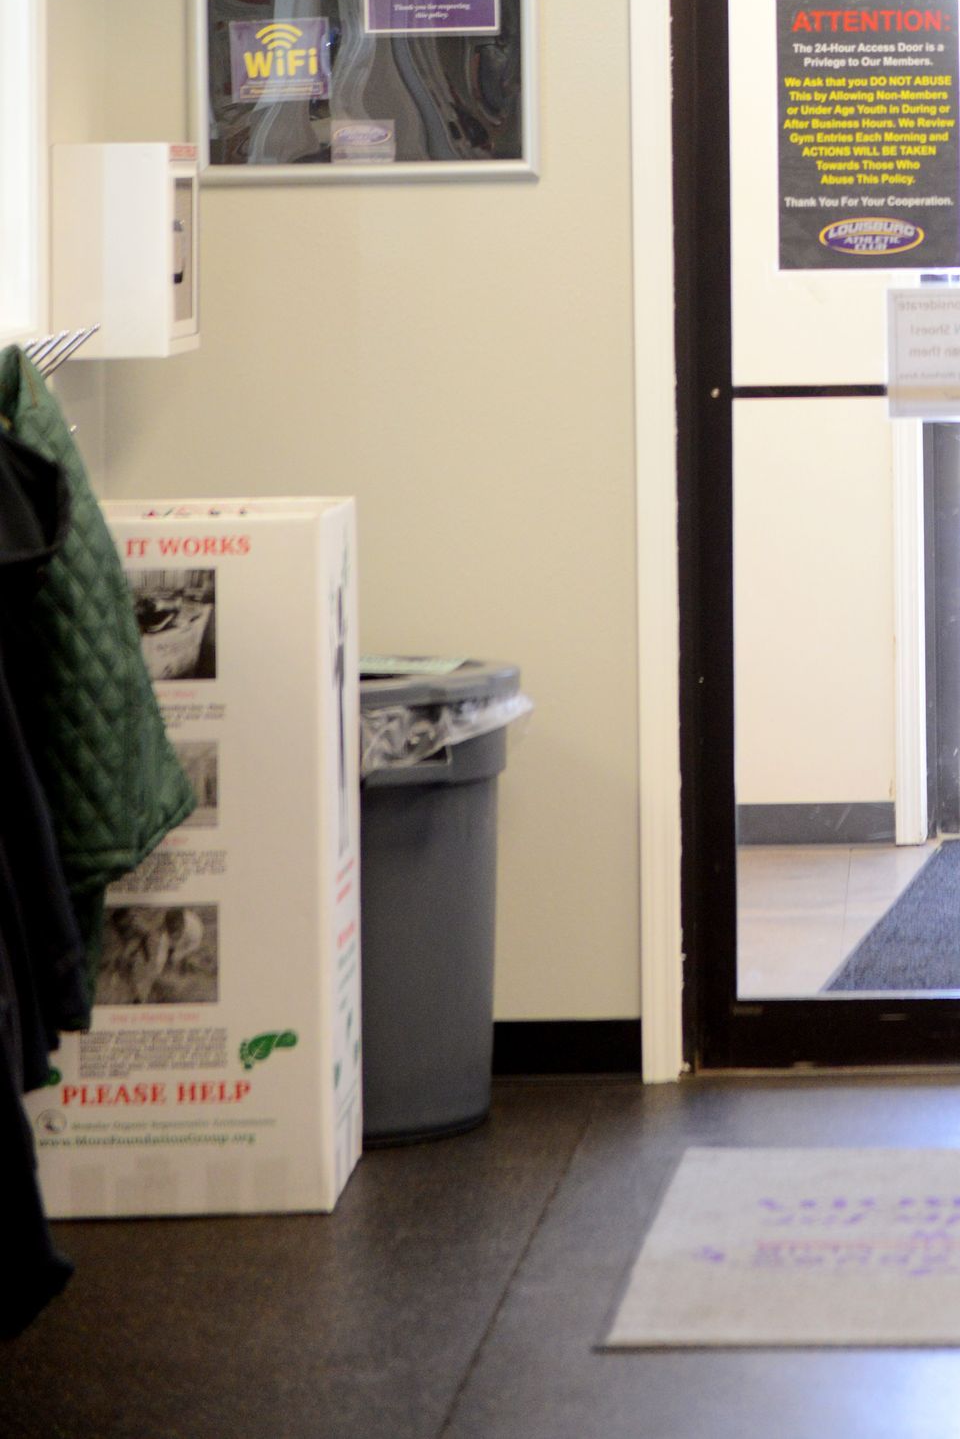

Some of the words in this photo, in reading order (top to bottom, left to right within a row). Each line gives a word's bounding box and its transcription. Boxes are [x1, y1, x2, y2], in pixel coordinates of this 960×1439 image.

[792, 10, 950, 33] ATTENTION:
[793, 43, 812, 53] The
[815, 43, 856, 53] 24-Hour
[857, 43, 895, 52] Access
[898, 42, 923, 52] Door
[925, 43, 935, 52] is
[243, 47, 318, 78] WiFi
[848, 58, 859, 66] to
[861, 57, 881, 66] Our
[883, 57, 933, 66] Members.
[785, 78, 801, 87] We
[803, 78, 823, 87] Ask
[826, 78, 846, 86] that
[848, 79, 868, 88] you
[870, 76, 887, 86] DO
[889, 76, 912, 86] NOT
[914, 76, 951, 85] ABUSE
[790, 91, 812, 101] This
[814, 92, 827, 102] by
[829, 91, 874, 102] Allowing
[876, 90, 948, 100] Non-Members
[801, 105, 832, 114] Under
[834, 105, 855, 116] Age
[857, 105, 887, 114] Youth
[902, 104, 937, 115] During
[939, 105, 950, 113] or
[784, 119, 809, 128] After
[811, 119, 859, 128] Business
[862, 119, 895, 128] Hours.
[898, 118, 915, 127] We
[917, 118, 954, 127] Review
[790, 133, 814, 145] Gym
[816, 133, 853, 142] Entries
[856, 132, 882, 142] Each
[884, 132, 927, 143] Morning
[929, 132, 948, 141] and
[803, 146, 851, 156] ACTIONS
[853, 146, 880, 156] WILL
[882, 146, 897, 155] BE
[900, 145, 936, 155] TAKEN
[816, 161, 860, 170] Towards
[862, 160, 894, 170] Those
[896, 160, 920, 169] Who
[821, 175, 854, 184] Abuse
[856, 174, 879, 183] This
[881, 174, 915, 185] Policy.
[784, 197, 816, 207] Thank
[819, 197, 839, 207] You
[841, 196, 859, 206] For
[861, 196, 885, 206] Your
[887, 196, 953, 207] Cooperation.
[126, 537, 148, 558] IT
[158, 535, 252, 557] WORKS
[61, 1083, 166, 1107] PLEASE
[177, 1080, 251, 1103] HELP
